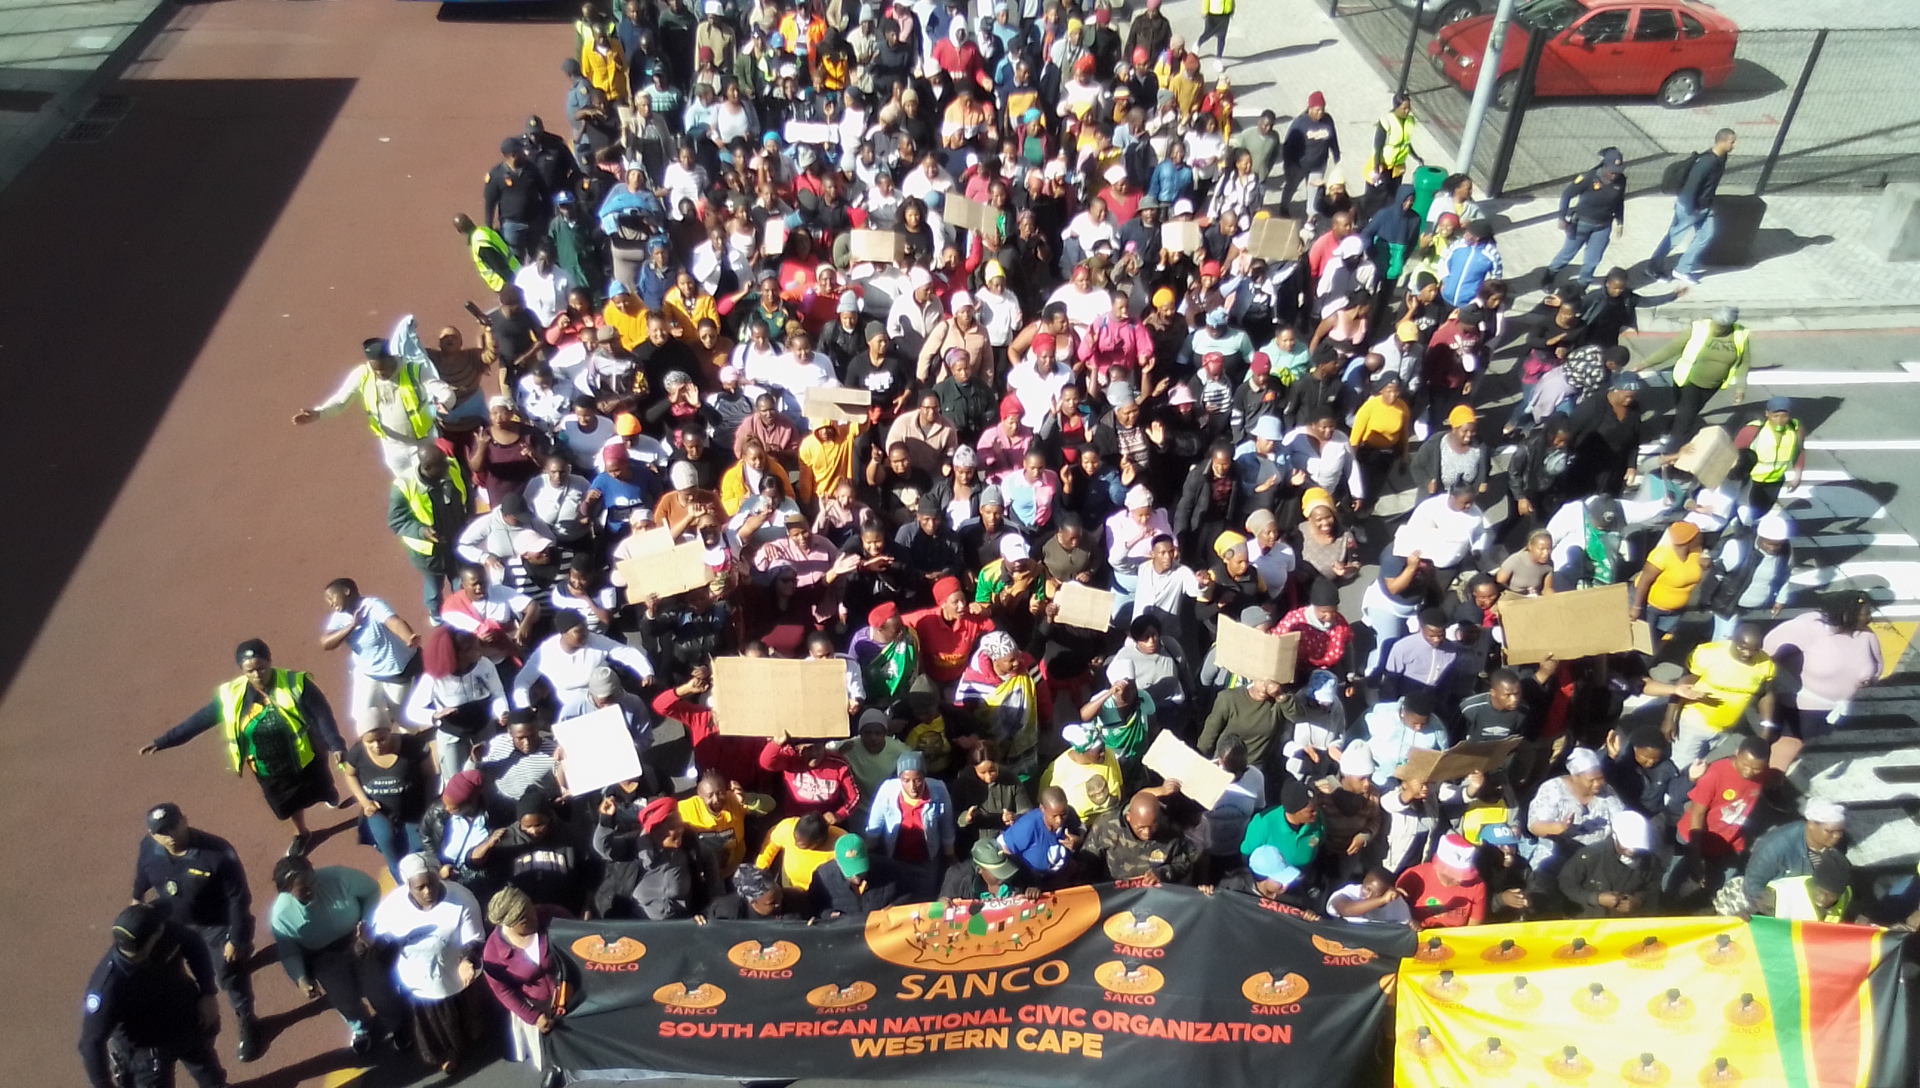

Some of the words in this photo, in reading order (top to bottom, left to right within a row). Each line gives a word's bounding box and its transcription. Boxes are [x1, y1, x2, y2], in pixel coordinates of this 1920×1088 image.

[1114, 879, 1162, 889] SAN
[1113, 943, 1165, 958] SANCO
[585, 961, 640, 972] SANCO
[1322, 954, 1370, 966] SANCO
[738, 967, 794, 979] SANCO
[896, 960, 1070, 1001] SANCO
[1103, 990, 1156, 1006] SANCO
[664, 1004, 718, 1015] SANCO
[815, 1002, 869, 1015] SANCO
[1250, 1003, 1301, 1016] SANCO
[659, 1021, 754, 1039] SOUTH
[759, 1018, 878, 1039] AFRICAN
[884, 1006, 1013, 1034] NATIONAL
[1018, 1004, 1087, 1028] CIVIC
[1092, 1010, 1292, 1045] ORGANIZATION
[851, 1028, 1009, 1058] WESTERN
[1016, 1027, 1104, 1058] CAPE
